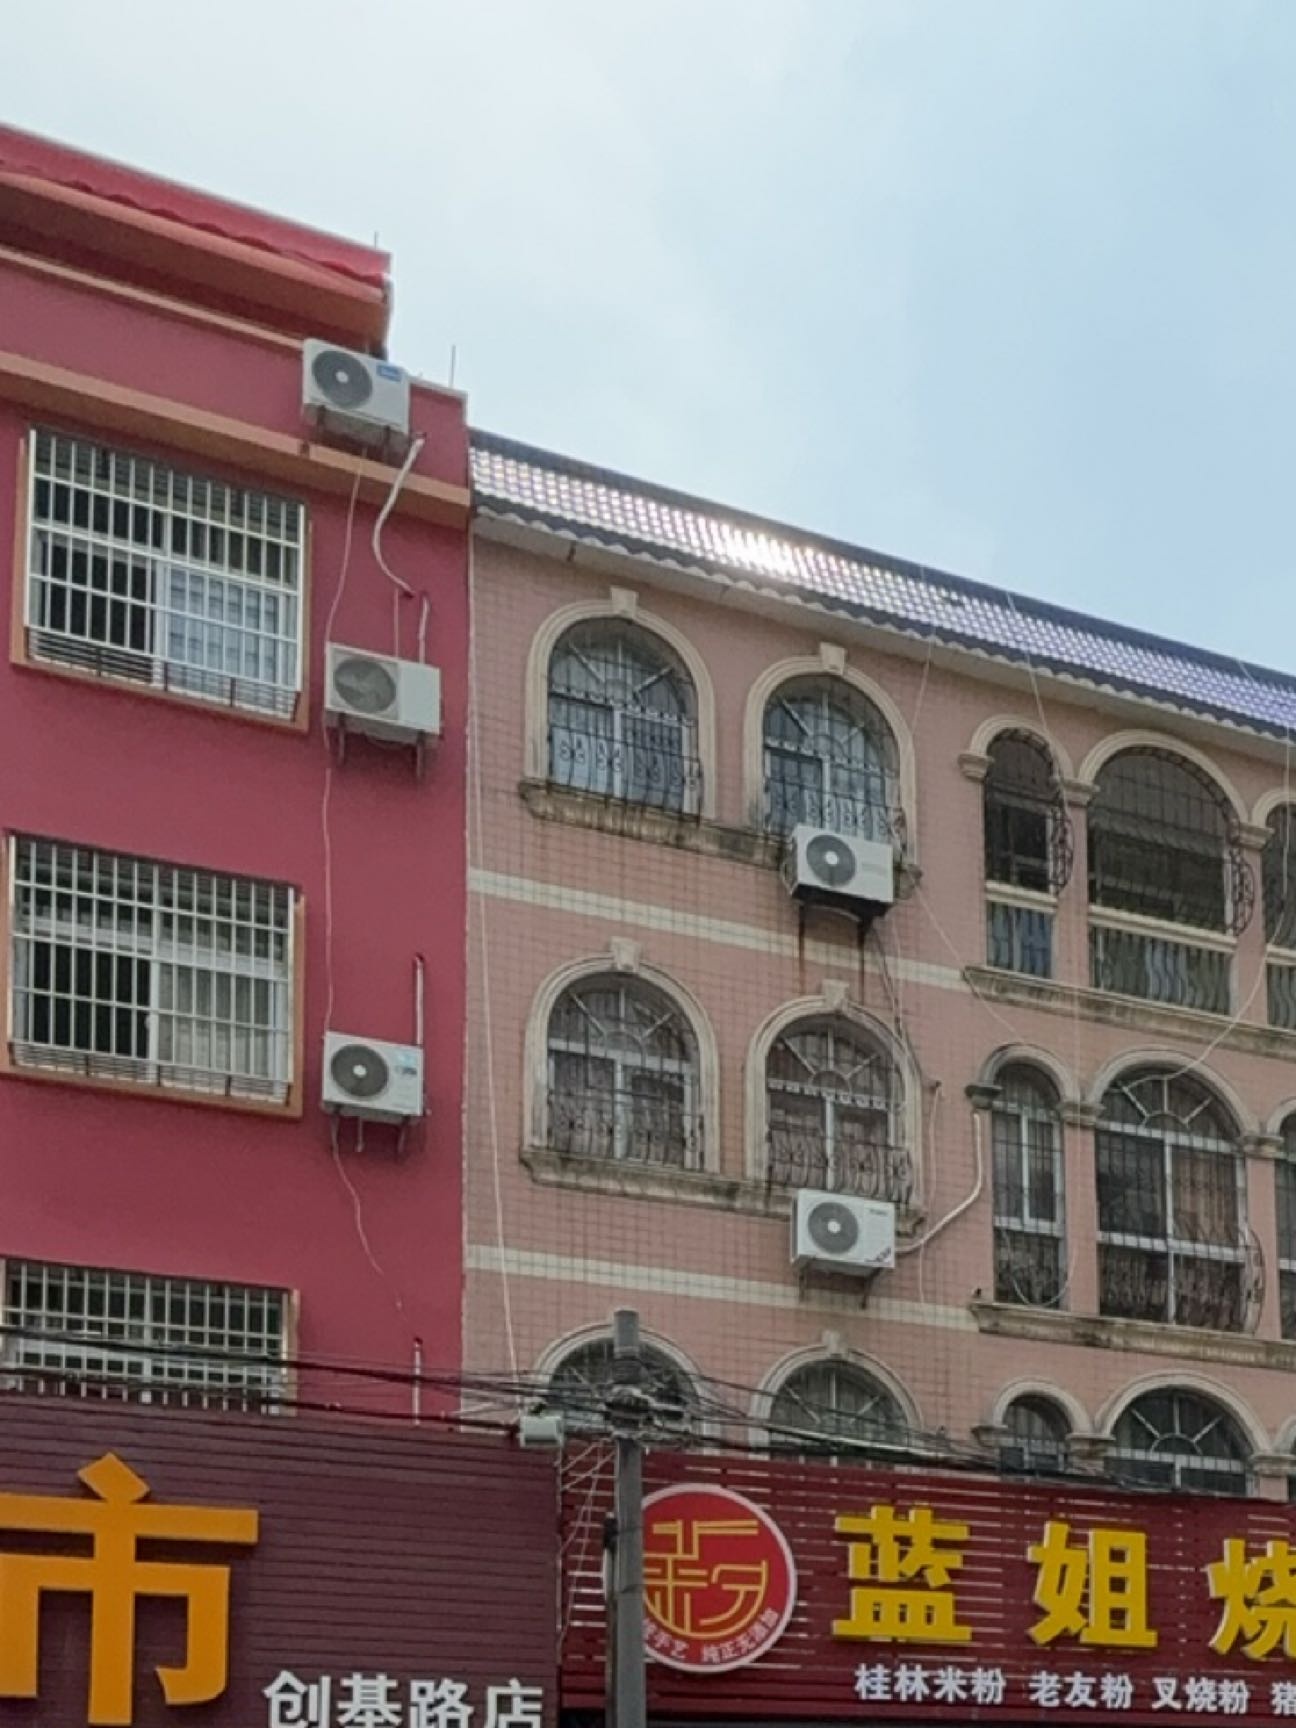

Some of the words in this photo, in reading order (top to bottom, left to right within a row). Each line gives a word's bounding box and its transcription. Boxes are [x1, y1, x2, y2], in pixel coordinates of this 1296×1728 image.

[0, 1452, 259, 1727] 市
[854, 1662, 1007, 1703] 桂林米粉
[1028, 1669, 1134, 1709] 老友粉
[1150, 1675, 1249, 1715] 叉烧粉
